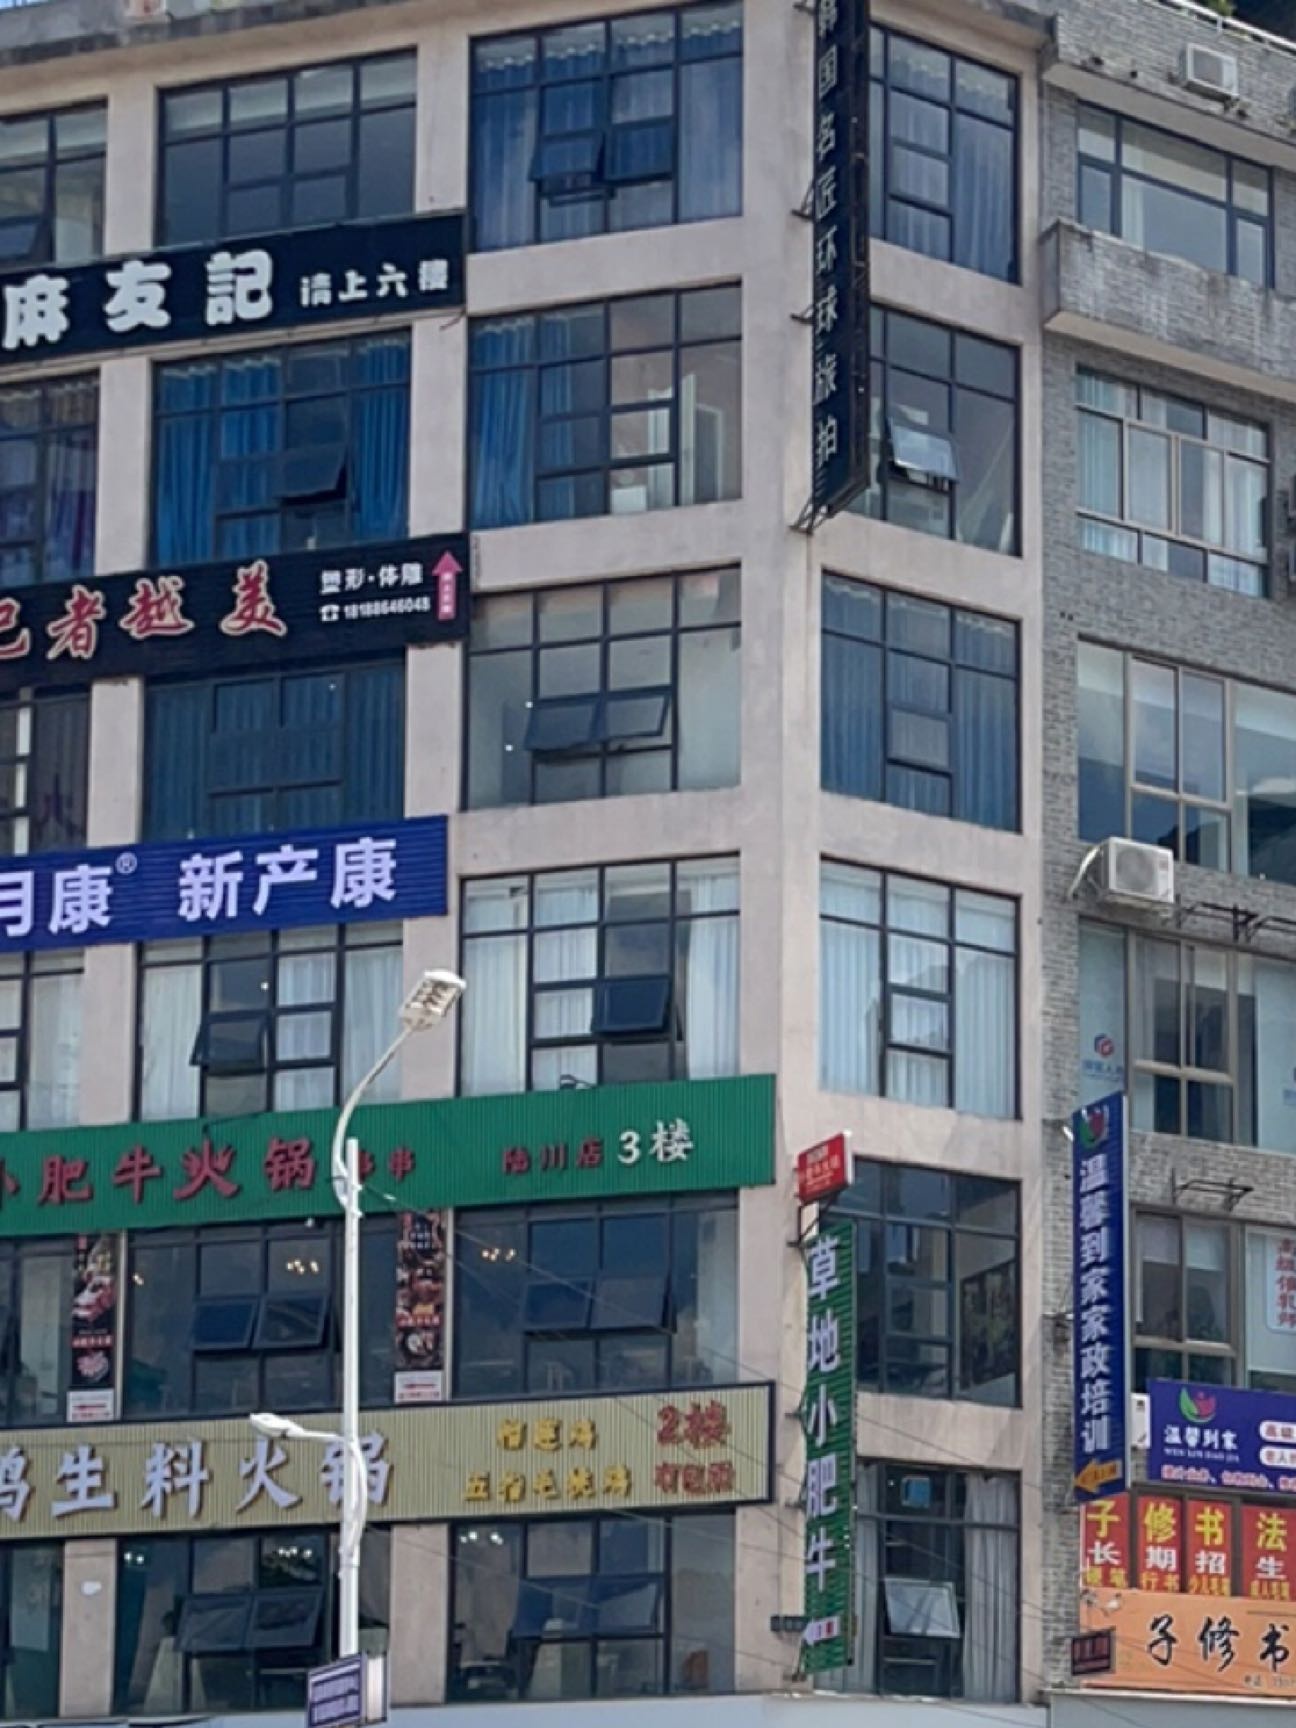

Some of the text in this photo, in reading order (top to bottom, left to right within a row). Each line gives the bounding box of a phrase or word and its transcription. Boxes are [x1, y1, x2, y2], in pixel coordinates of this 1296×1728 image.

[178, 837, 397, 922] 新产康
[617, 1117, 694, 1165] 3楼
[804, 1234, 842, 1593] 草地小肥牛
[1088, 1540, 1287, 1580] 长期招生
